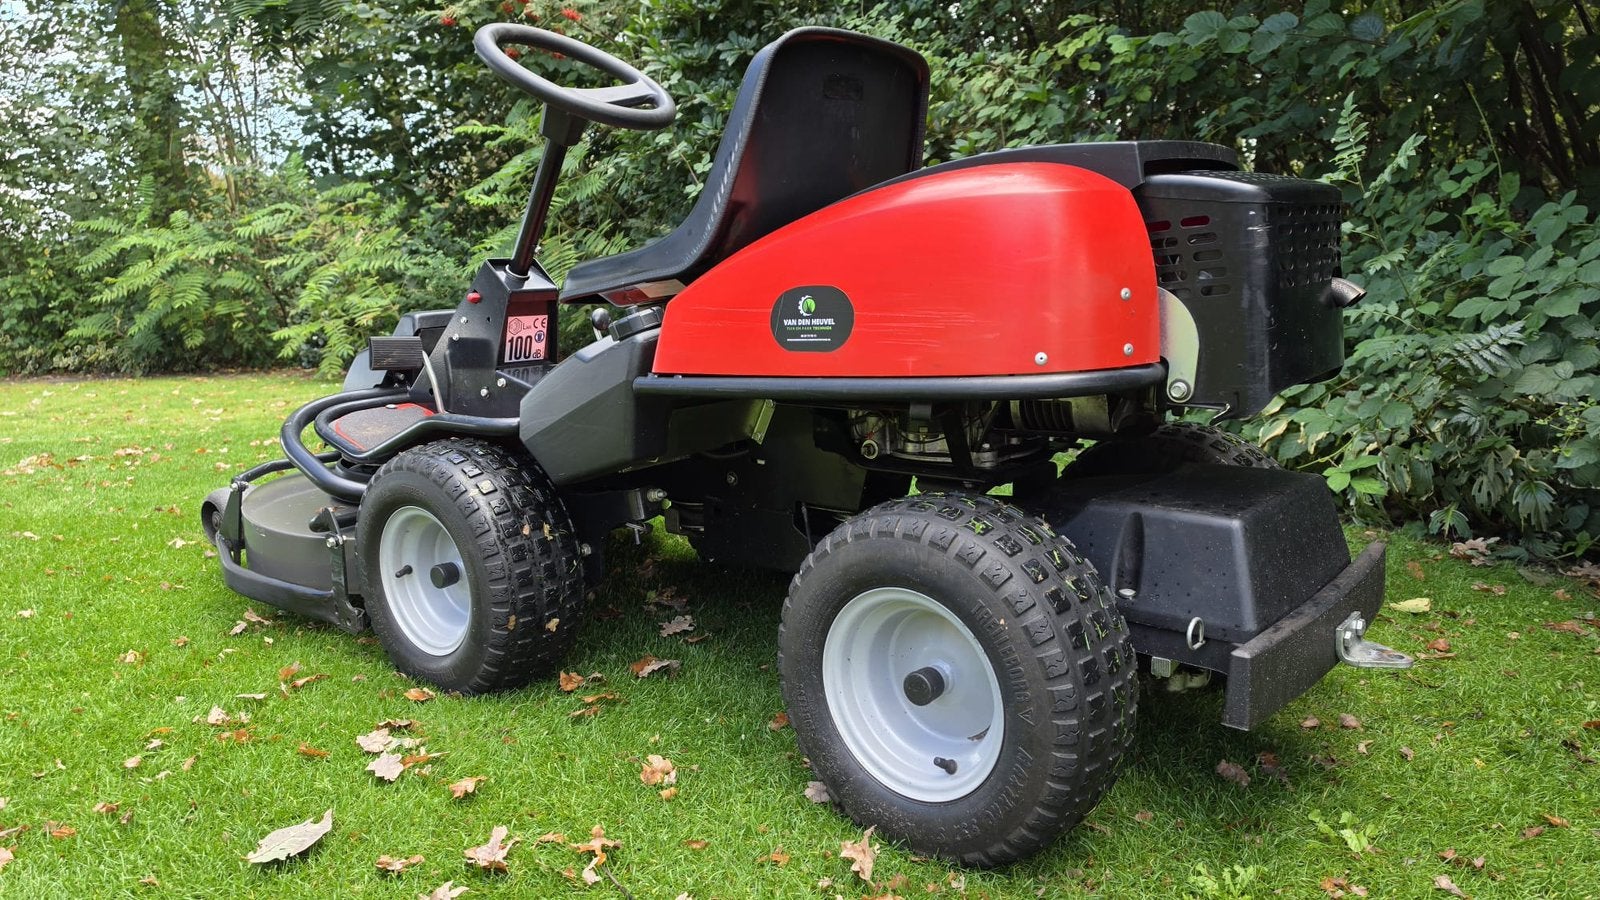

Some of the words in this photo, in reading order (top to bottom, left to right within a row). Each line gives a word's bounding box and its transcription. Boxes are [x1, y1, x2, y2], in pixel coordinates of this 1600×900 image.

[783, 318, 797, 326] VAN
[797, 318, 811, 326] DEN
[811, 318, 836, 326] HEUVEL
[508, 335, 533, 361] 100
[532, 348, 542, 359] dB
